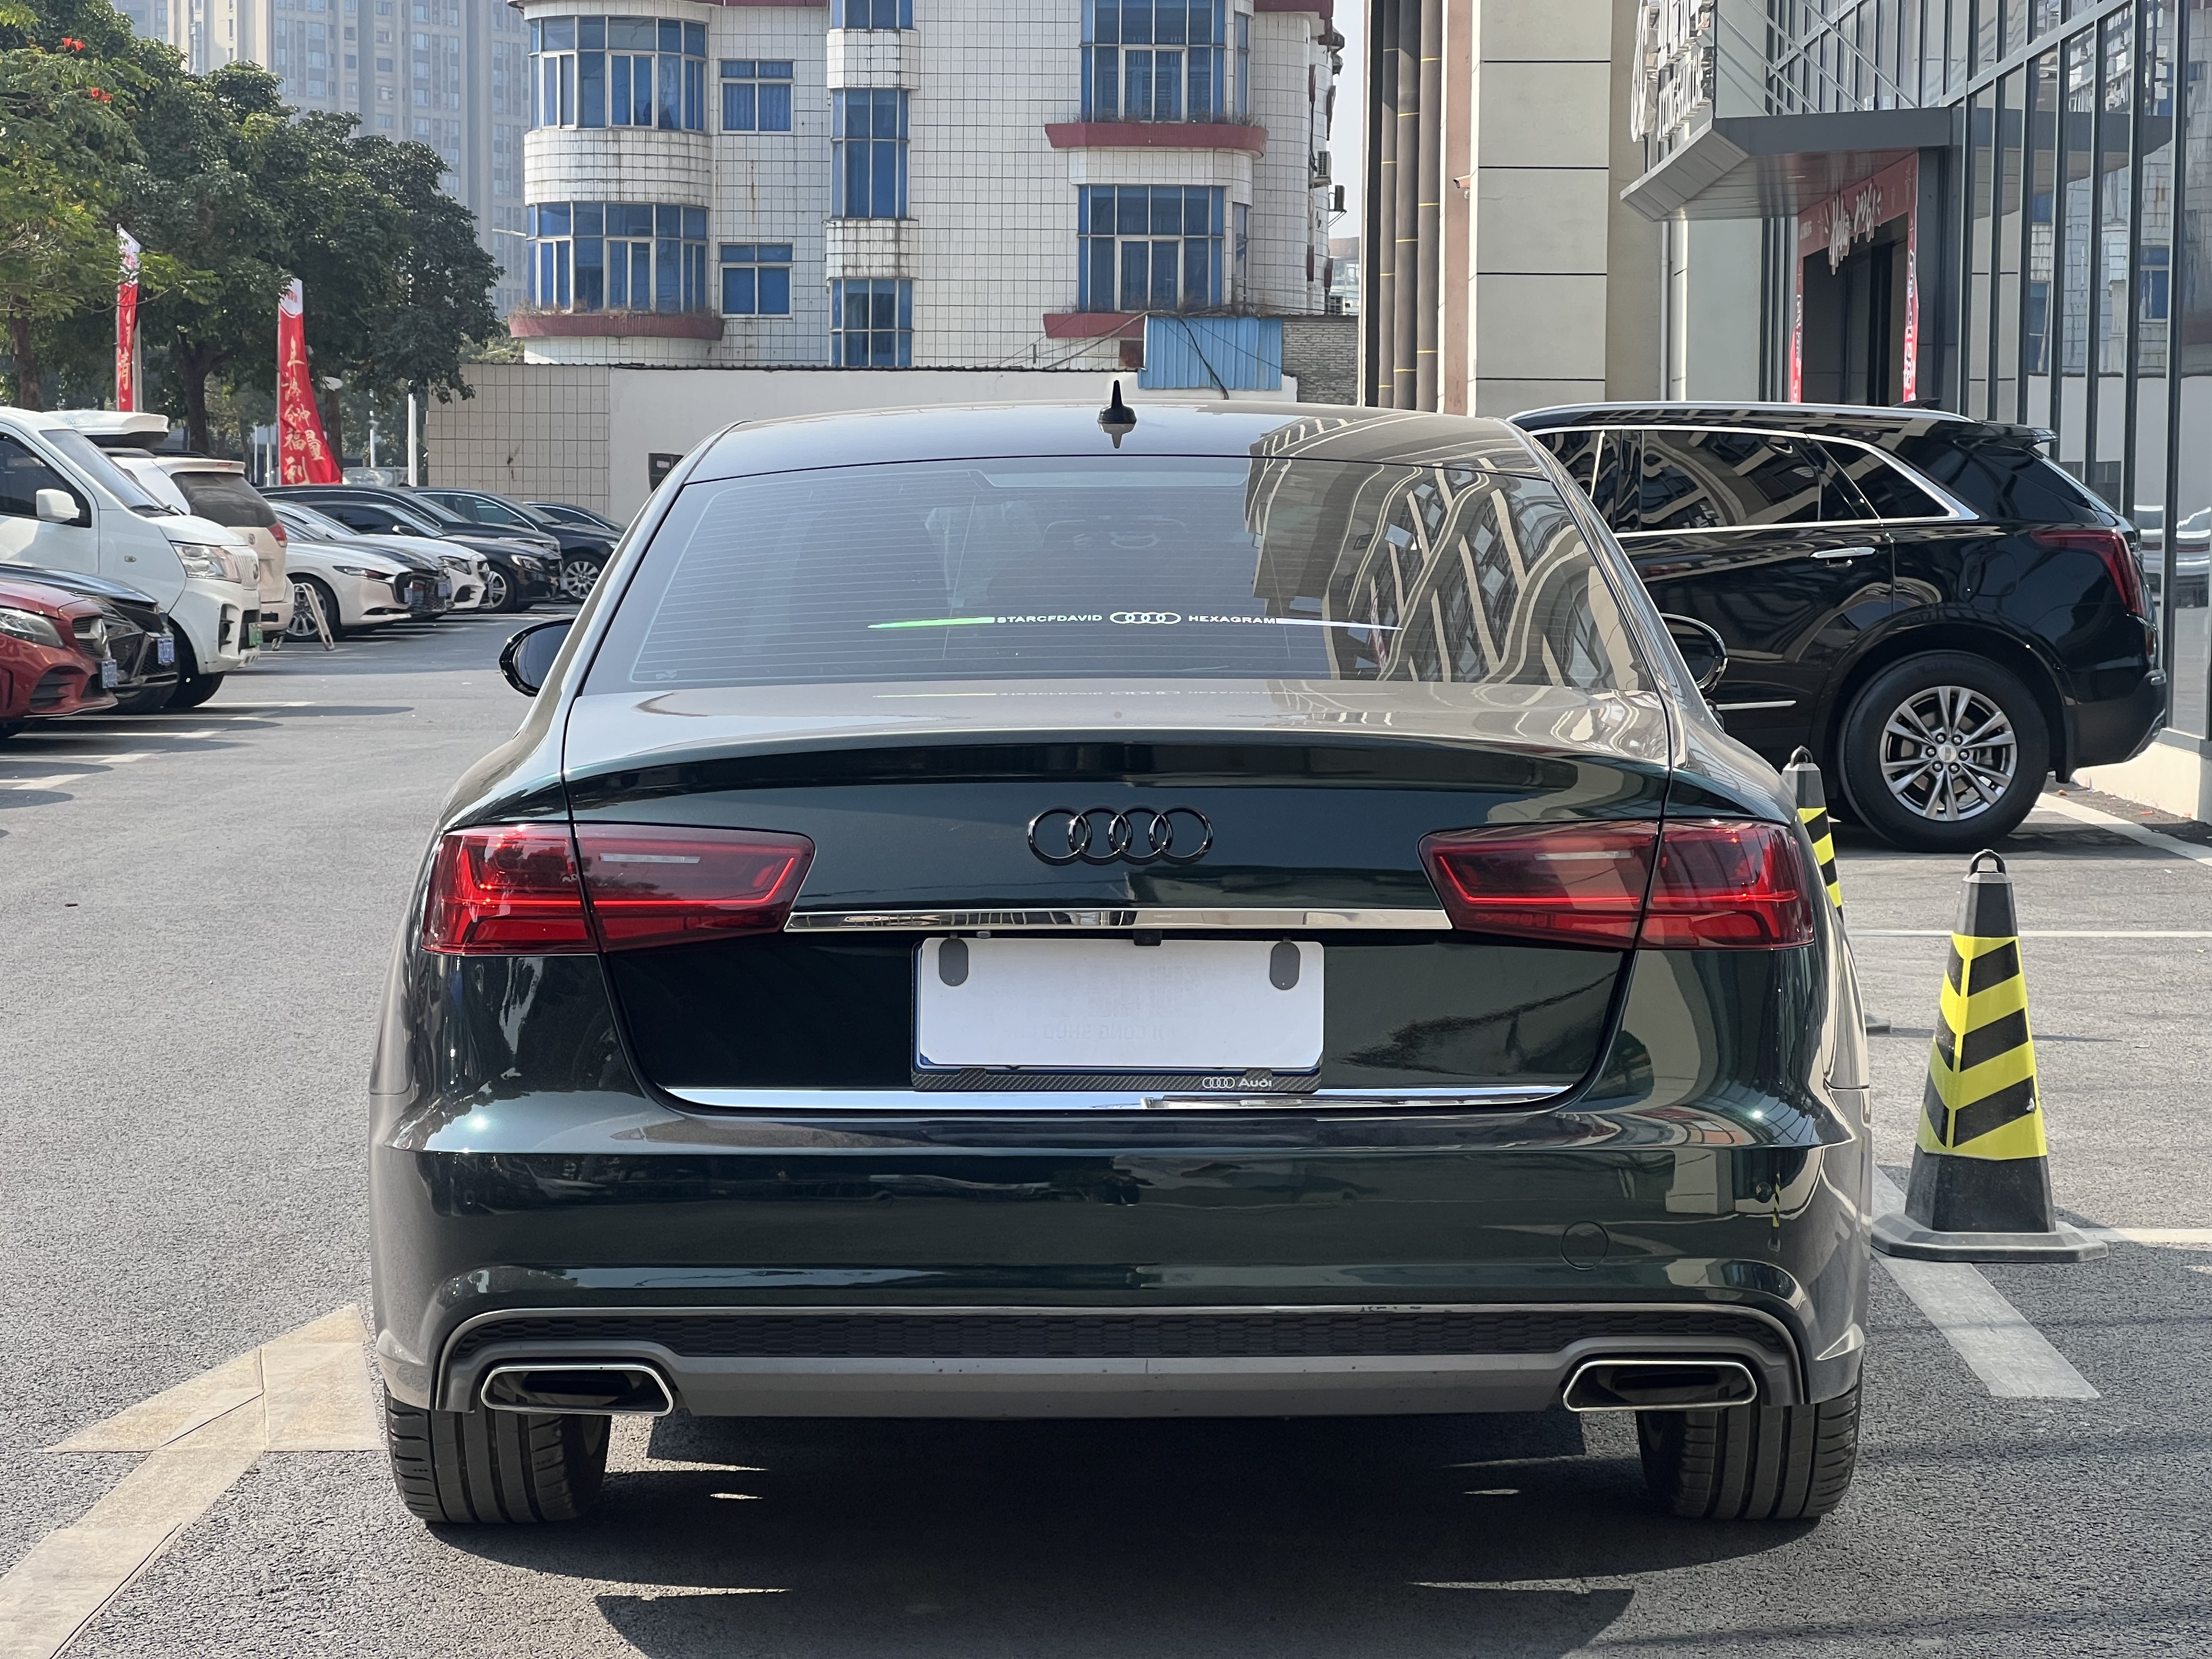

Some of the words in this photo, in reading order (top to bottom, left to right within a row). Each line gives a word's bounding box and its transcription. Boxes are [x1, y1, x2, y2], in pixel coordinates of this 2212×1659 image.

[997, 614, 1103, 623] STARCFDAVID
[1188, 616, 1276, 624] HEXAGRAM
[1238, 1078, 1272, 1087] Audi
